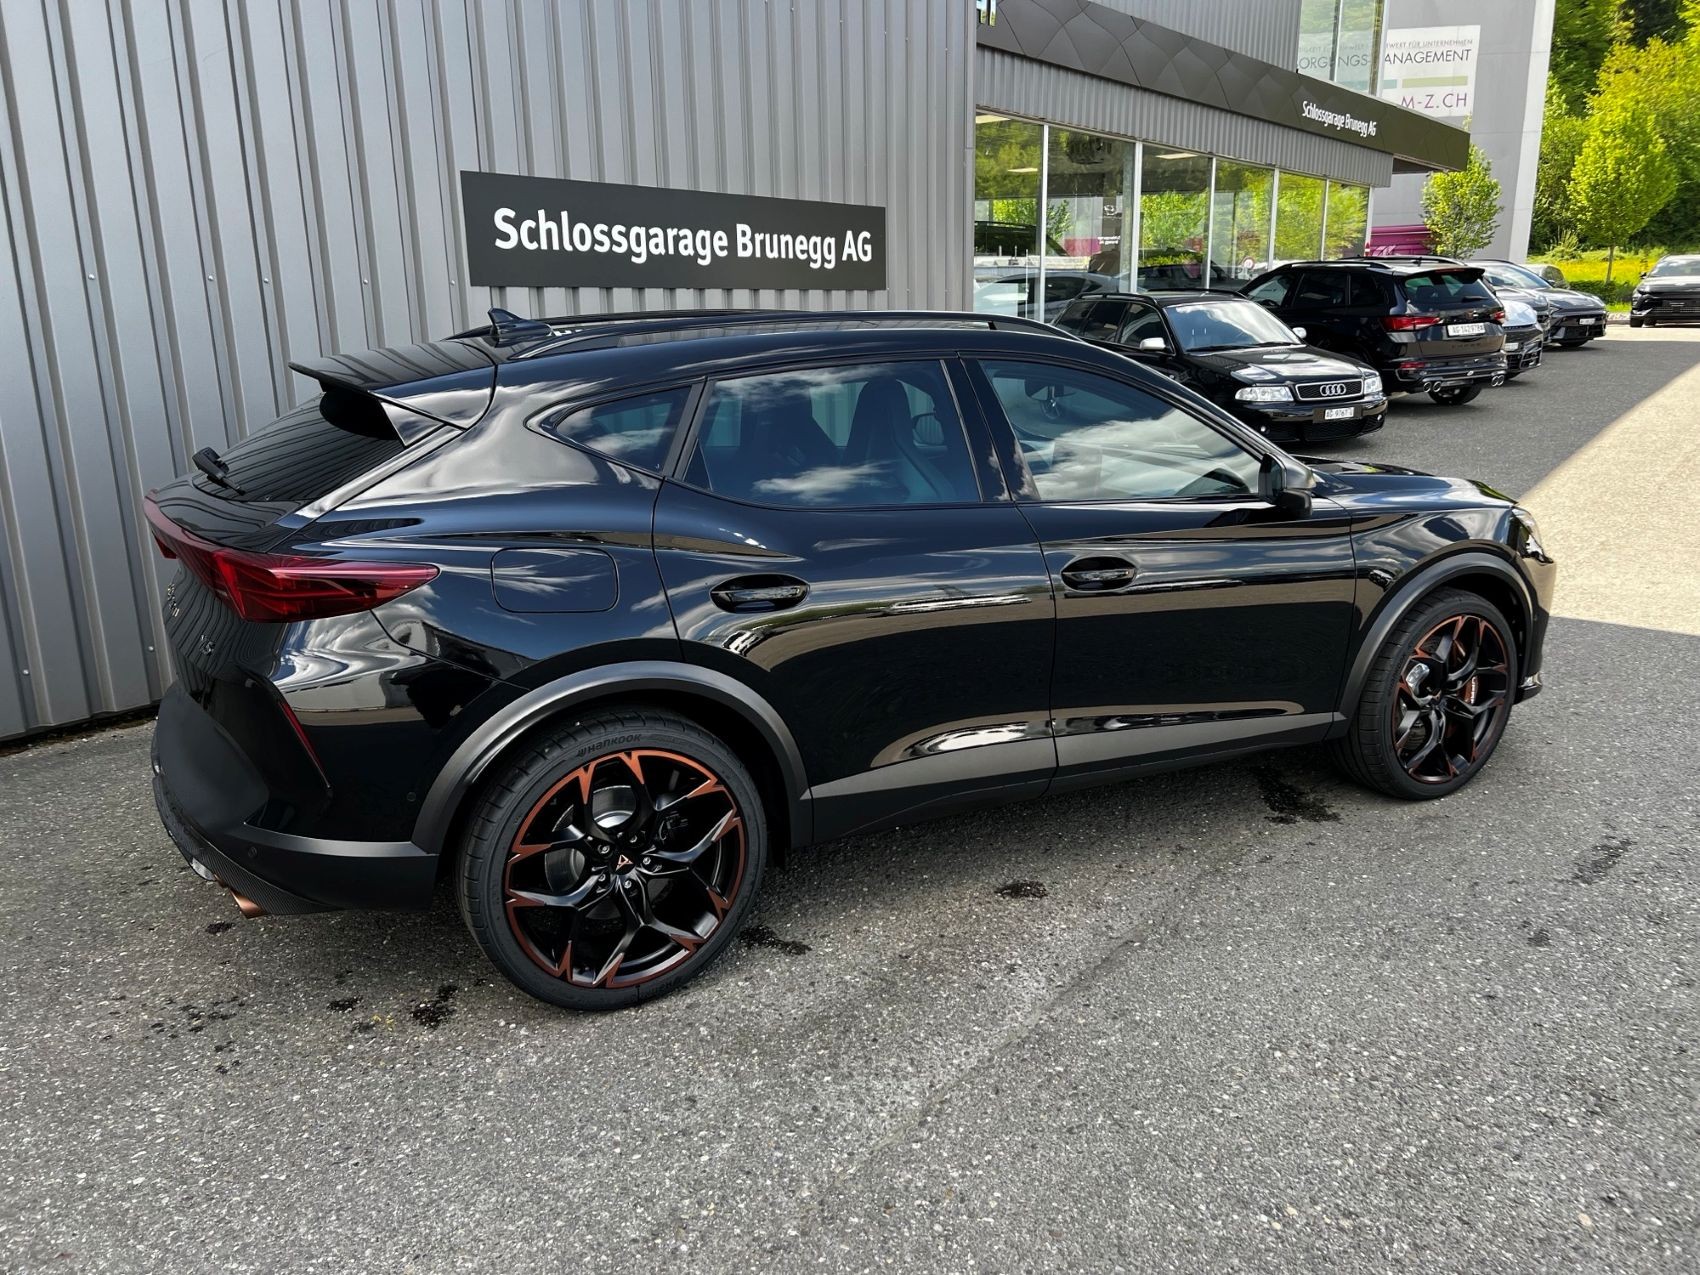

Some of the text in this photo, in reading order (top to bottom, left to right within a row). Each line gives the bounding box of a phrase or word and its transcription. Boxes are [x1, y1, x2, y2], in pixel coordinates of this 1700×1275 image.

[1423, 39, 1473, 47] UNTERNEHMEN
[1384, 49, 1472, 64] ANAGEMENT
[1302, 101, 1377, 137] Schlossgarage Brunegg AG
[493, 207, 872, 269] Schlossgarage Brunegg AG
